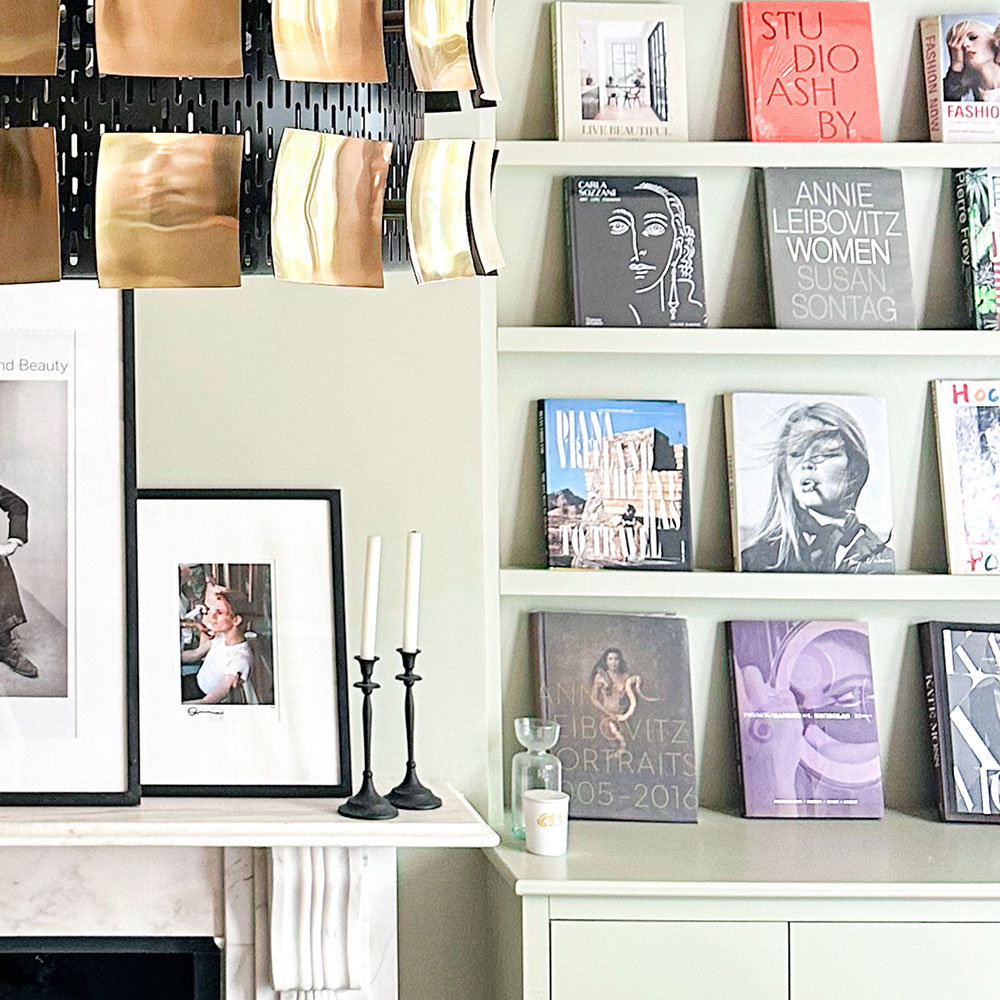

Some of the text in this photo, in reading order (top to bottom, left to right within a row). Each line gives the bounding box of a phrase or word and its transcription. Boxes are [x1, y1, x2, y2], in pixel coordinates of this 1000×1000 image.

[761, 10, 823, 40] STU
[793, 43, 859, 73] DIO
[766, 77, 837, 107] ASH
[925, 34, 940, 133] FASHION NOW
[581, 125, 672, 137] LIVE BEAUTIFUL
[818, 110, 857, 140] BY
[795, 181, 874, 208] ANNIE
[772, 207, 903, 238] LEIBOVITZ
[785, 236, 892, 266] WOMEN
[796, 265, 888, 293] SUSAN
[791, 293, 899, 323] SONTAG
[18, 358, 69, 374] Beauty
[556, 410, 614, 441] DIANA
[552, 714, 688, 744] EIBOVITZ
[555, 747, 698, 777] ORTRAITS
[563, 781, 699, 810] 05-2016
